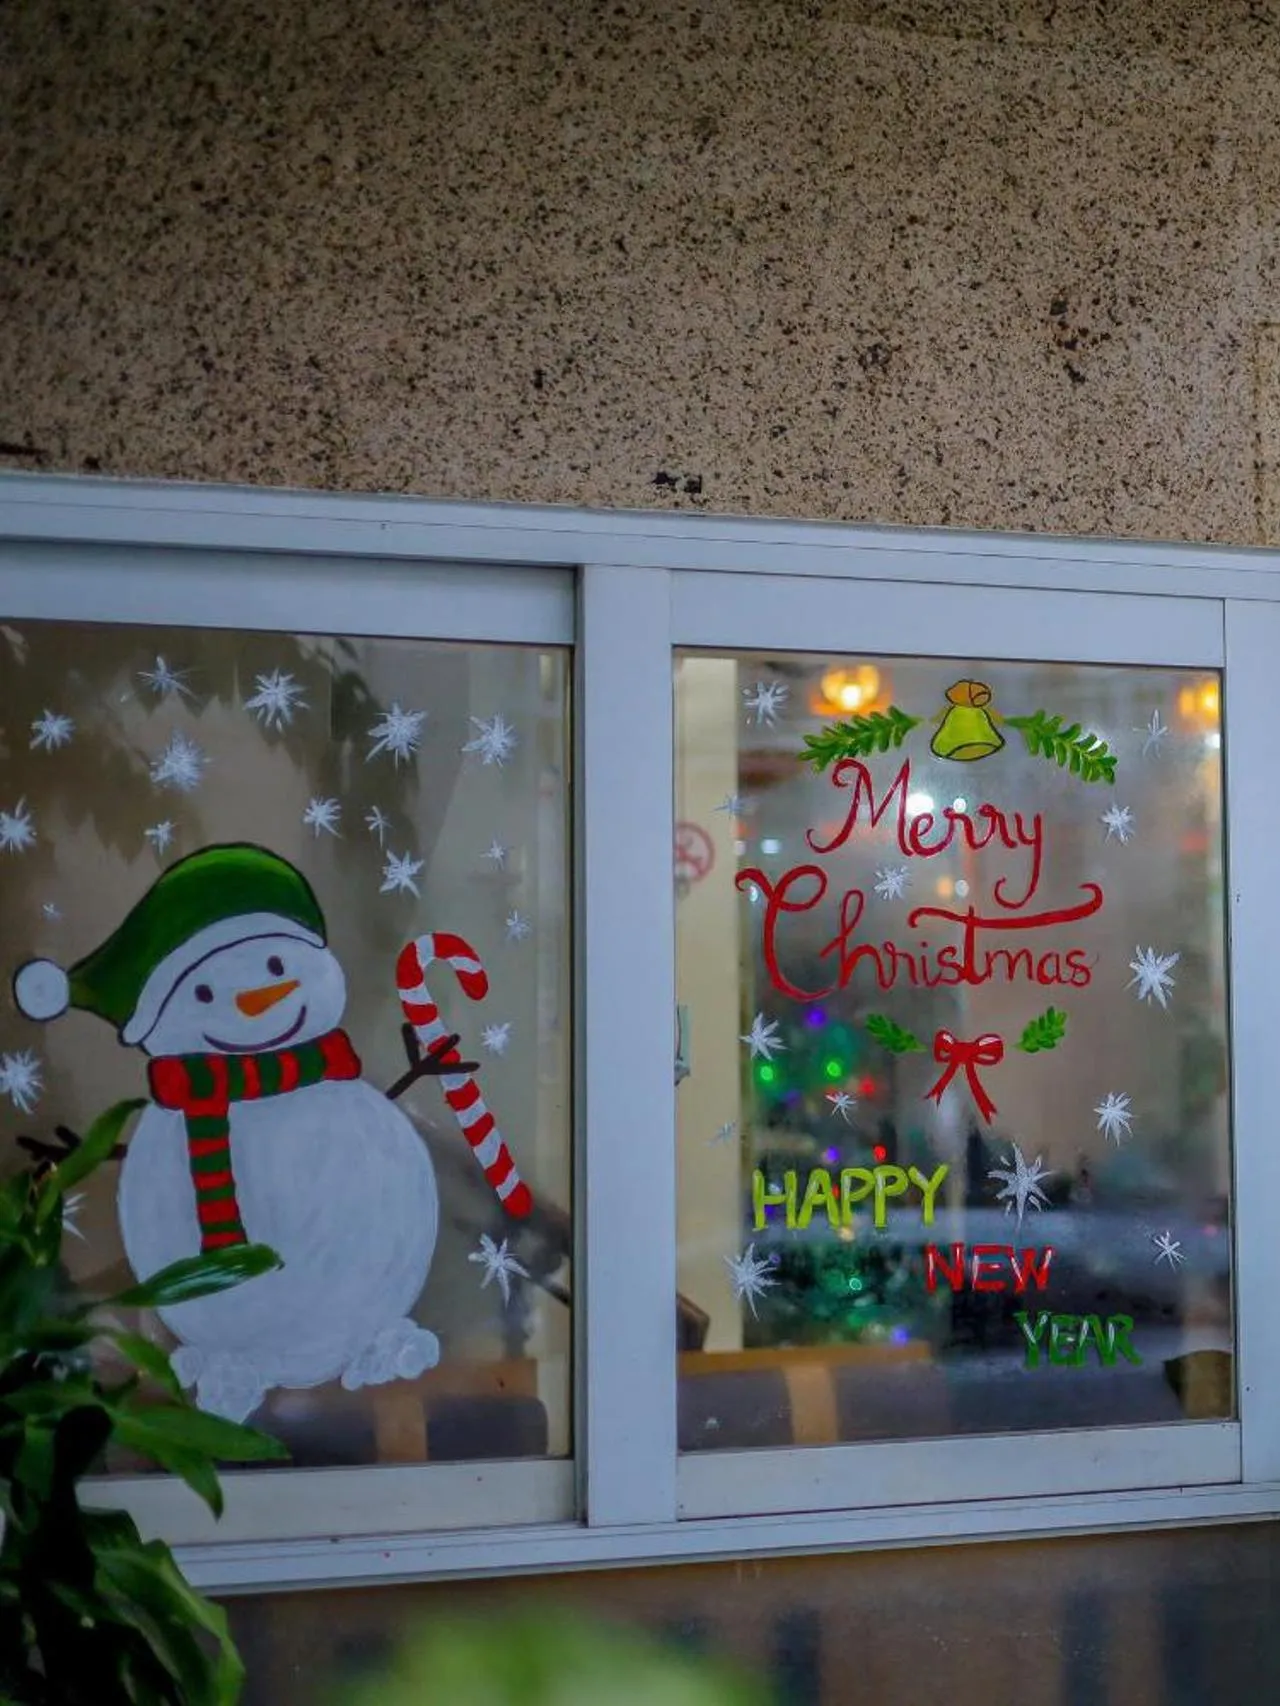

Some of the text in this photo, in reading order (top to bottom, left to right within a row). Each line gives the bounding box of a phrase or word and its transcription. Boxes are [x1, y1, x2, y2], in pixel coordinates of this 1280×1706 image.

[805, 757, 1045, 908] Merry
[735, 864, 1103, 1000] Christmas
[751, 1163, 949, 1232] HAPPY
[924, 1242, 1056, 1294] NEW
[1013, 1310, 1143, 1371] YEAR
